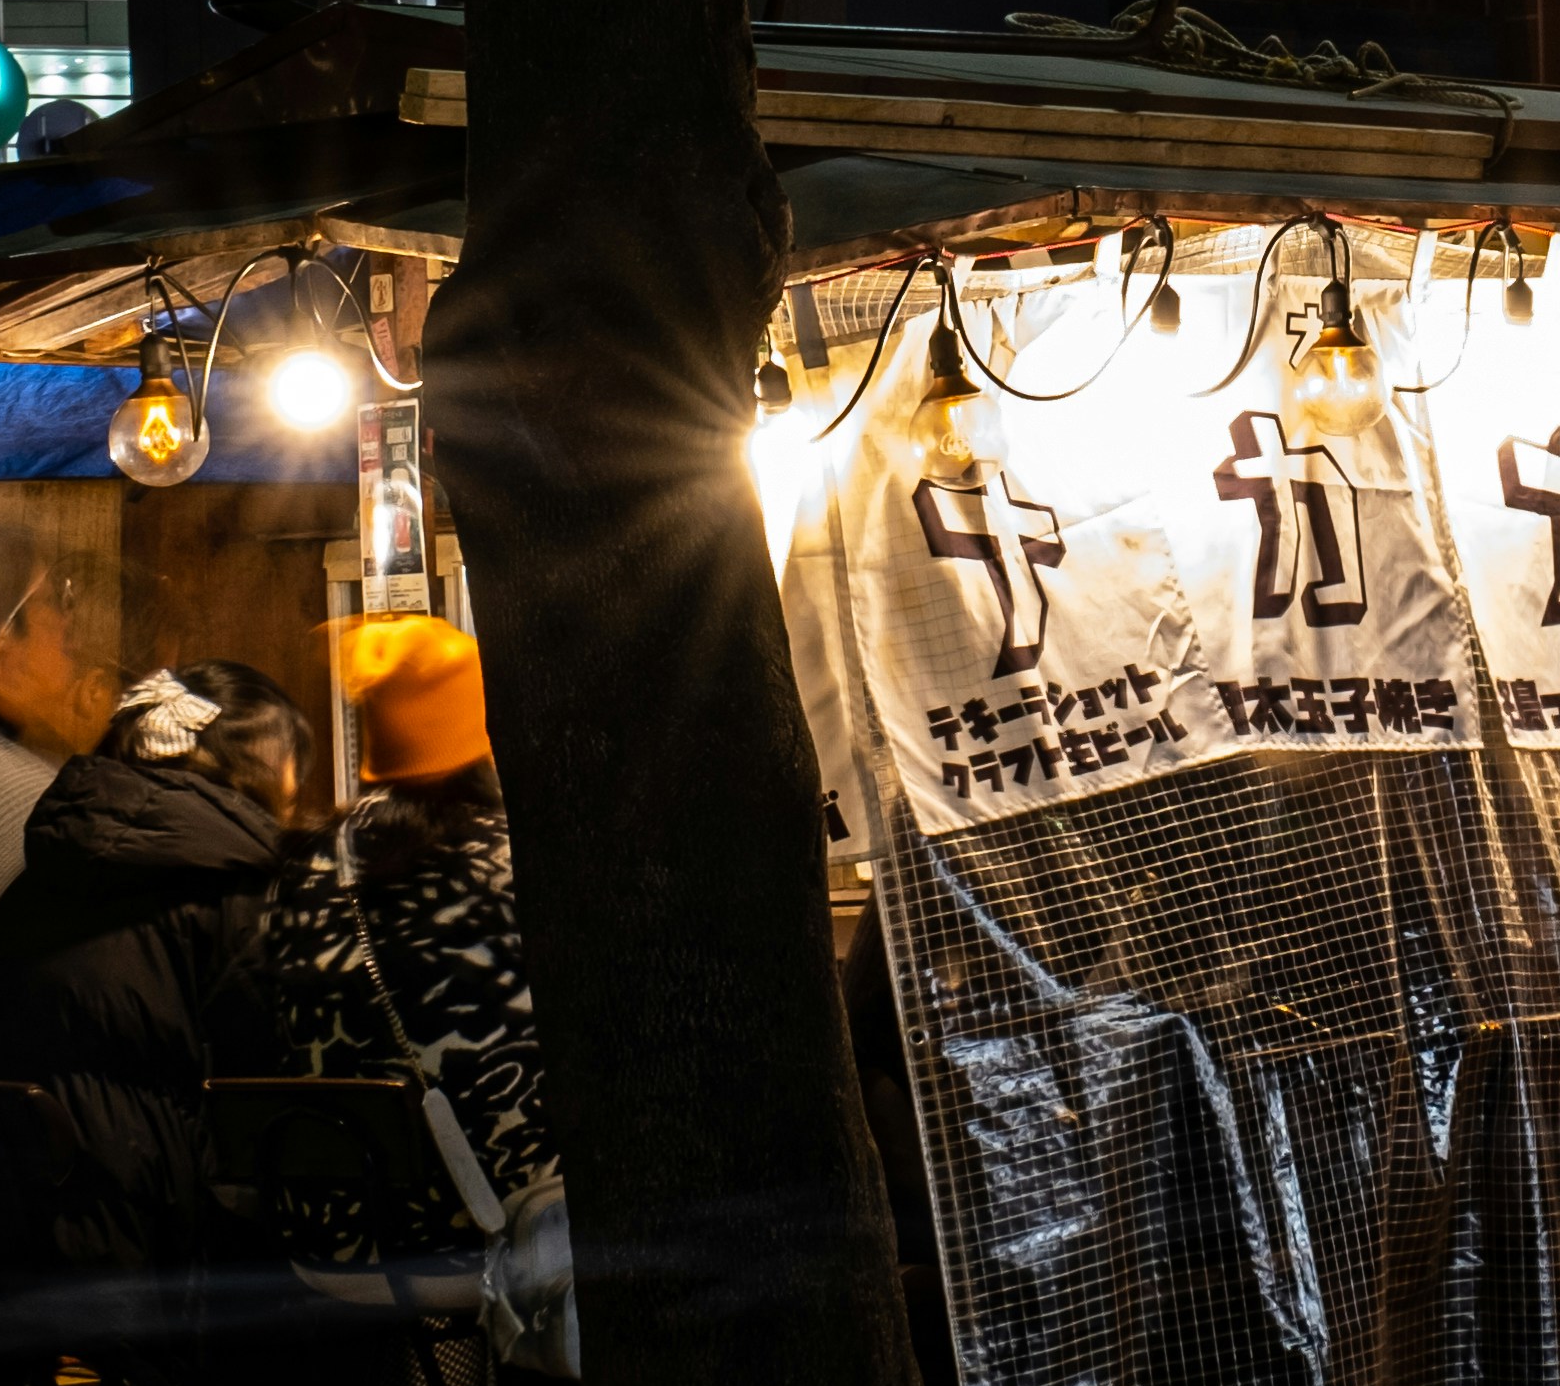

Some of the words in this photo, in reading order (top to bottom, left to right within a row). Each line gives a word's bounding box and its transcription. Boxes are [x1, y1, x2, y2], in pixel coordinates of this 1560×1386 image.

[941, 709, 1188, 799] クラフト生ビール
